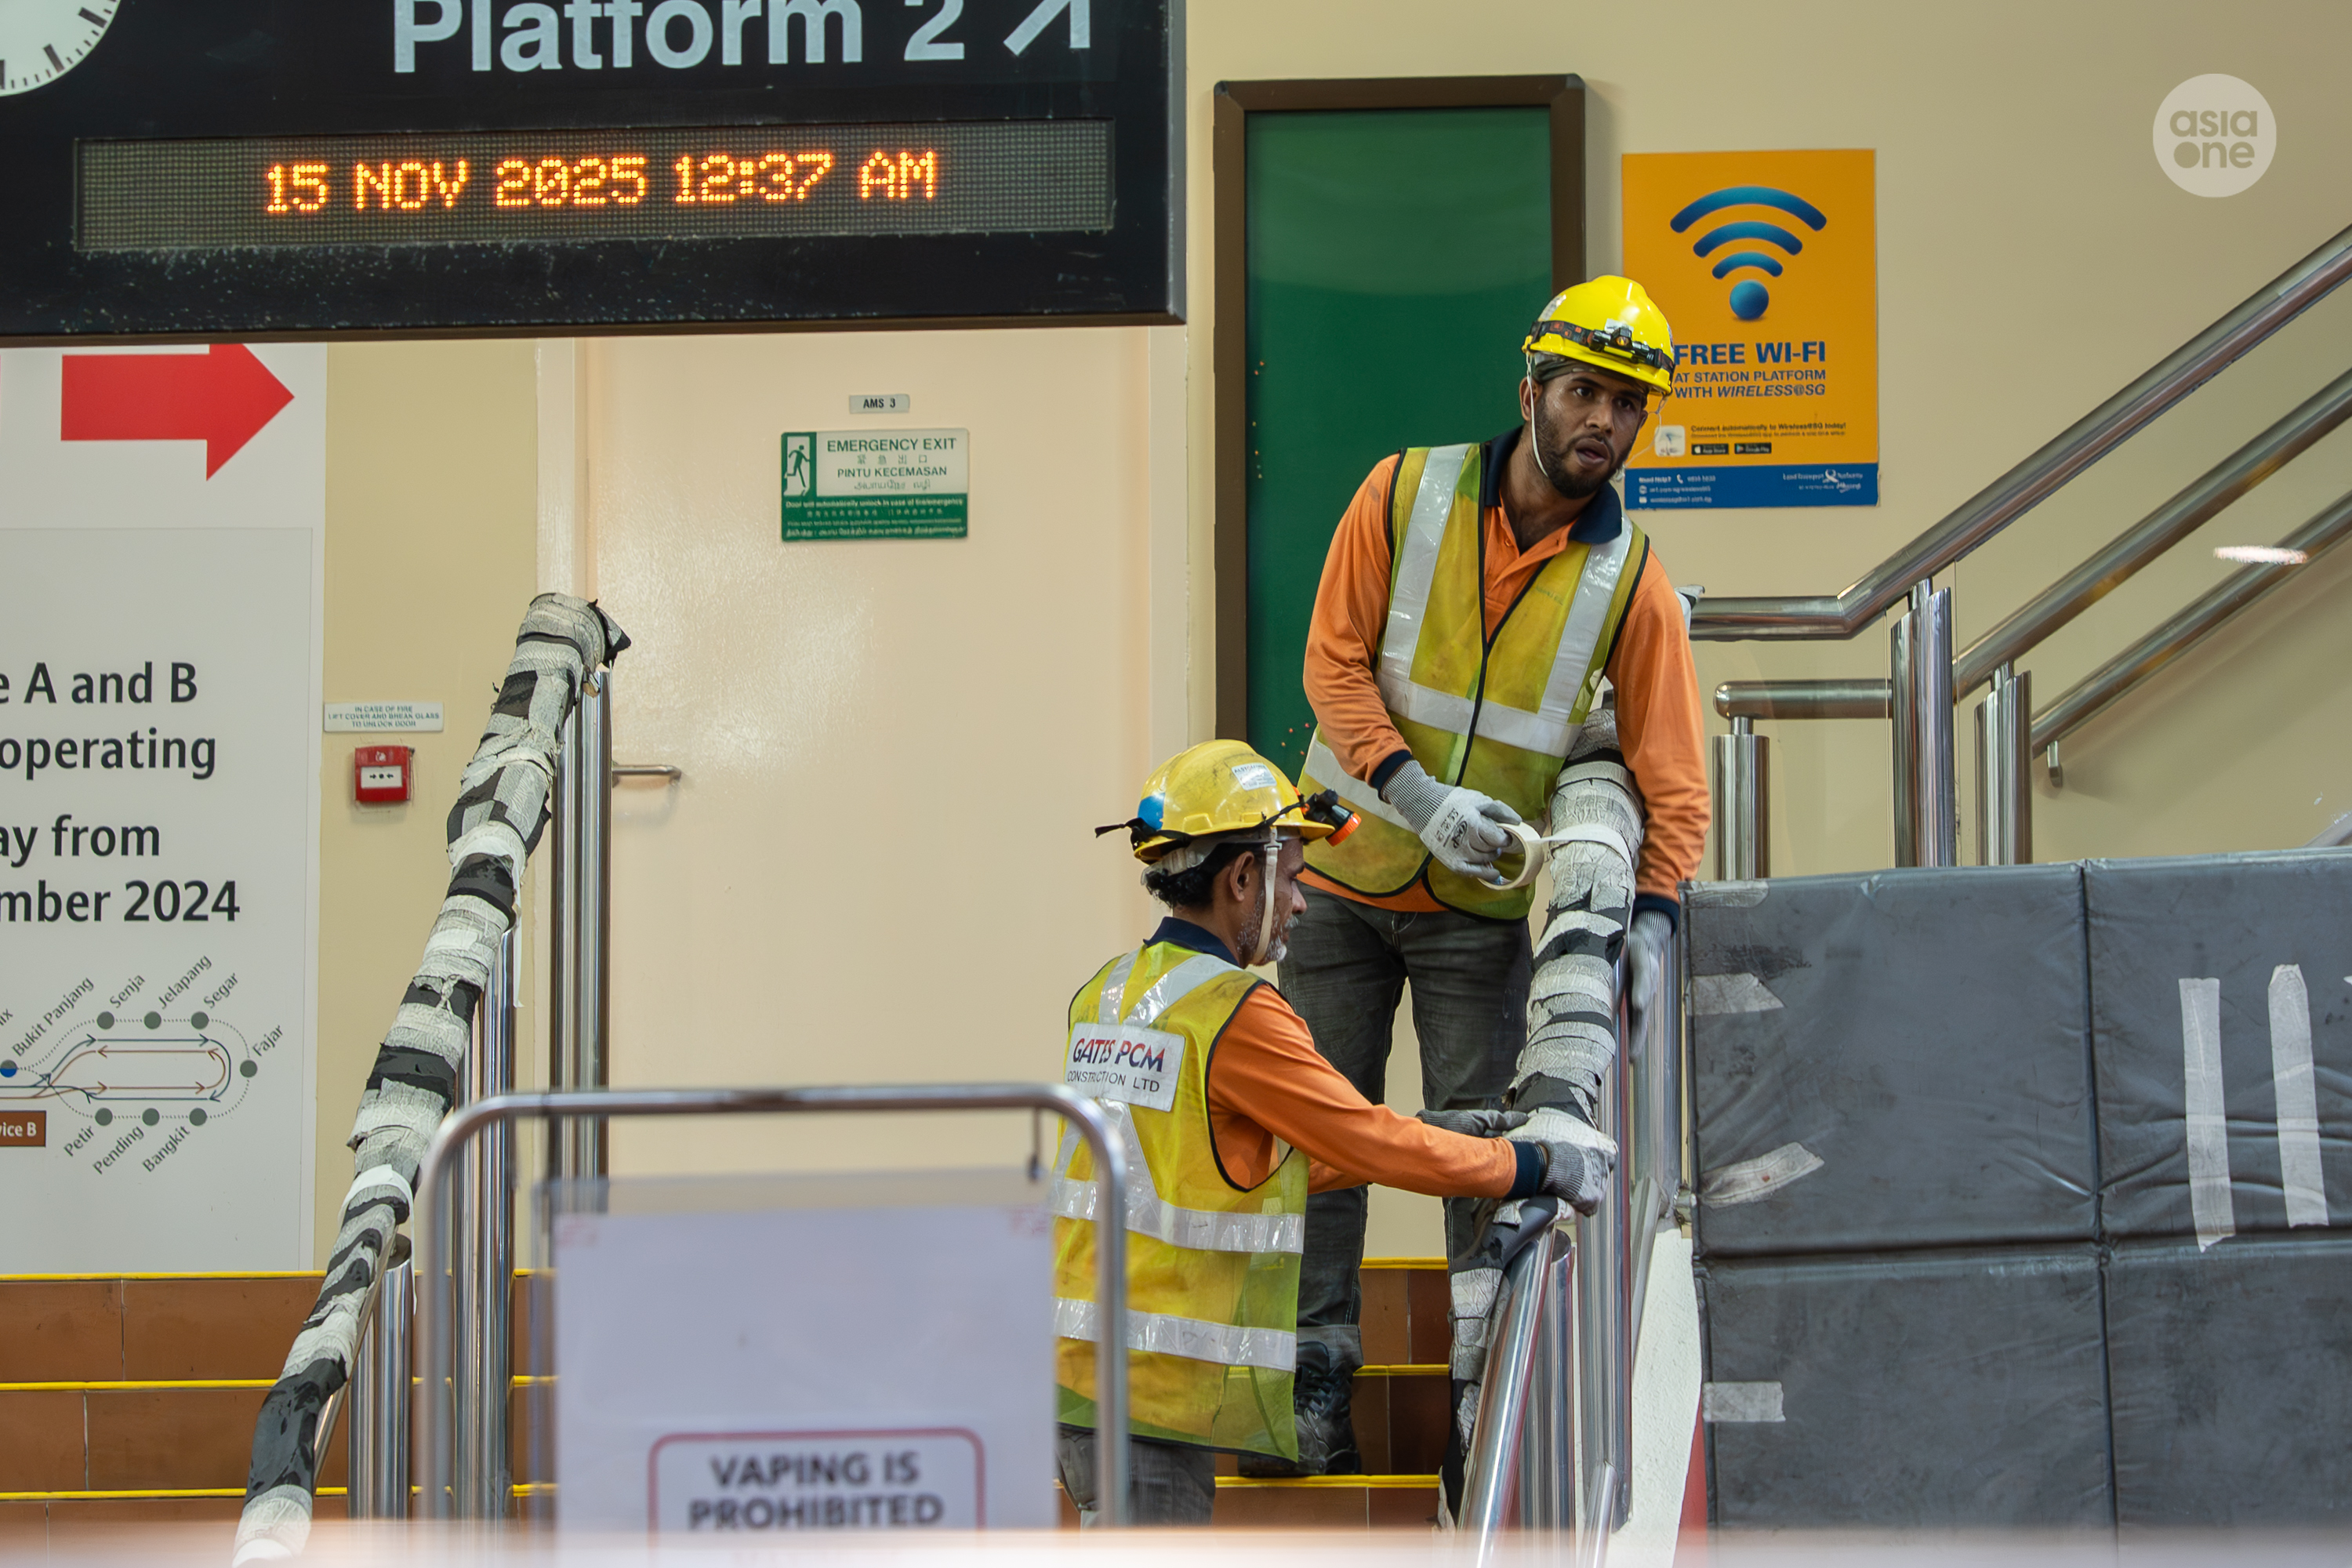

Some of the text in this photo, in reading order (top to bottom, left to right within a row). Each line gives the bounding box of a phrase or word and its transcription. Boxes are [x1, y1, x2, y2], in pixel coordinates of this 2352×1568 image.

[394, 0, 965, 73] Platform 2
[265, 149, 935, 212] 15 NOV 2025 12:37 AM
[1674, 341, 1826, 365] FREE WI-FI
[1675, 369, 1826, 383] AT STATION PLATFORM
[1675, 383, 1826, 398] WITH WIRELESS@SG
[863, 398, 895, 408] AMS 3
[827, 437, 956, 452] EMERGENCY EXIT
[837, 466, 947, 478] PINTU KECEMASAN
[24, 662, 57, 703] A
[71, 661, 153, 704] and
[171, 662, 198, 703] B
[0, 727, 216, 779] operating
[52, 814, 161, 857] from
[0, 879, 241, 922] mber 2024
[109, 972, 147, 1010] Senja
[158, 953, 212, 1010] Jelapang
[203, 971, 240, 1009] Segar
[12, 977, 94, 1057] Bukit Panjang
[252, 1024, 285, 1058] Fajar
[1115, 1040, 1166, 1073] PCM
[1067, 1069, 1160, 1093] CONSTRCTION LTD
[0, 1121, 37, 1137] ice B
[63, 1125, 96, 1158] Petir
[93, 1126, 145, 1174] Pending
[142, 1125, 191, 1172] Bangkit
[710, 1450, 921, 1489] VAPING IS
[688, 1493, 944, 1530] PROHIBITED
